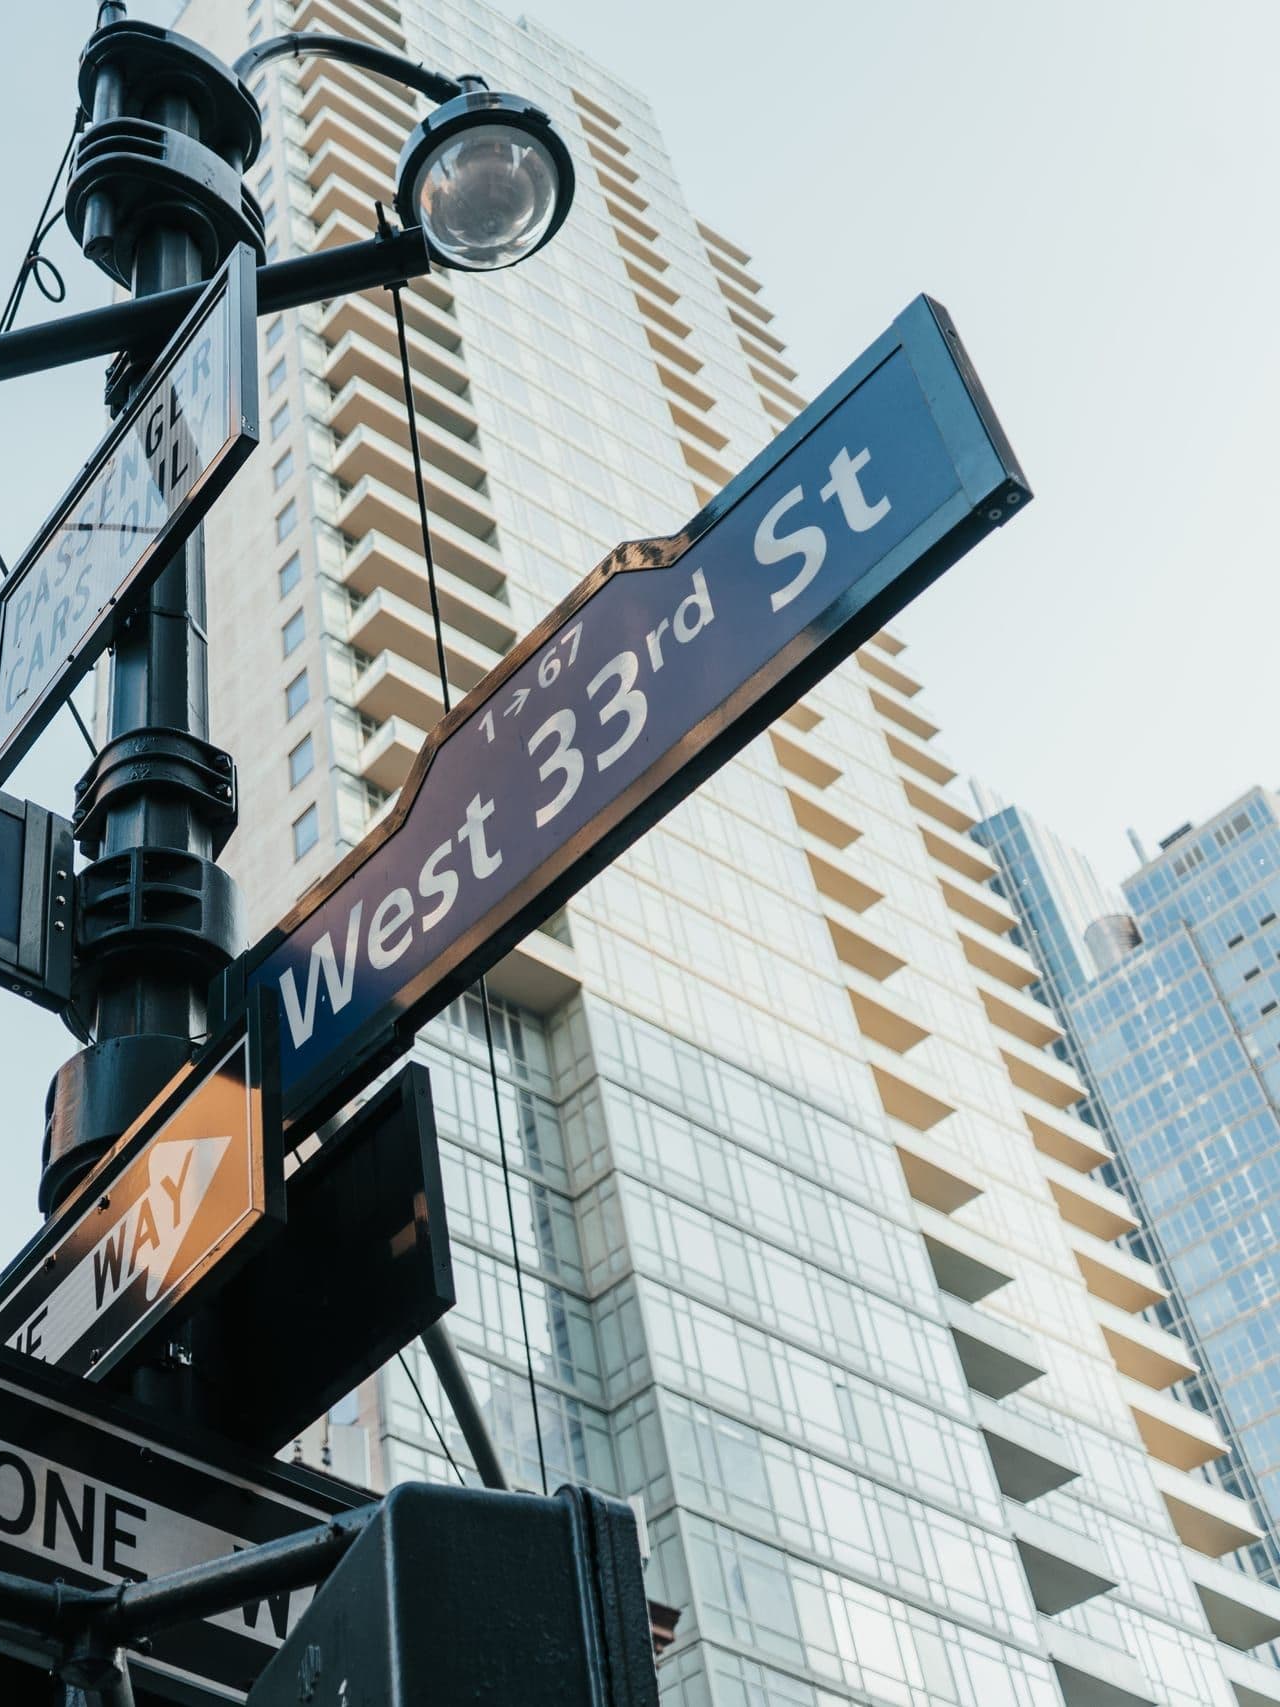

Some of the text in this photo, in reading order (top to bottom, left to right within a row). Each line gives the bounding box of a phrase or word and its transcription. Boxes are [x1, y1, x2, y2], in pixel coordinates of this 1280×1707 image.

[6, 392, 212, 712] CARS ONLY
[14, 336, 212, 638] PASSENGER
[277, 445, 892, 1050] West 33rd St
[477, 621, 584, 744] 1 67
[93, 1145, 194, 1312] WAY
